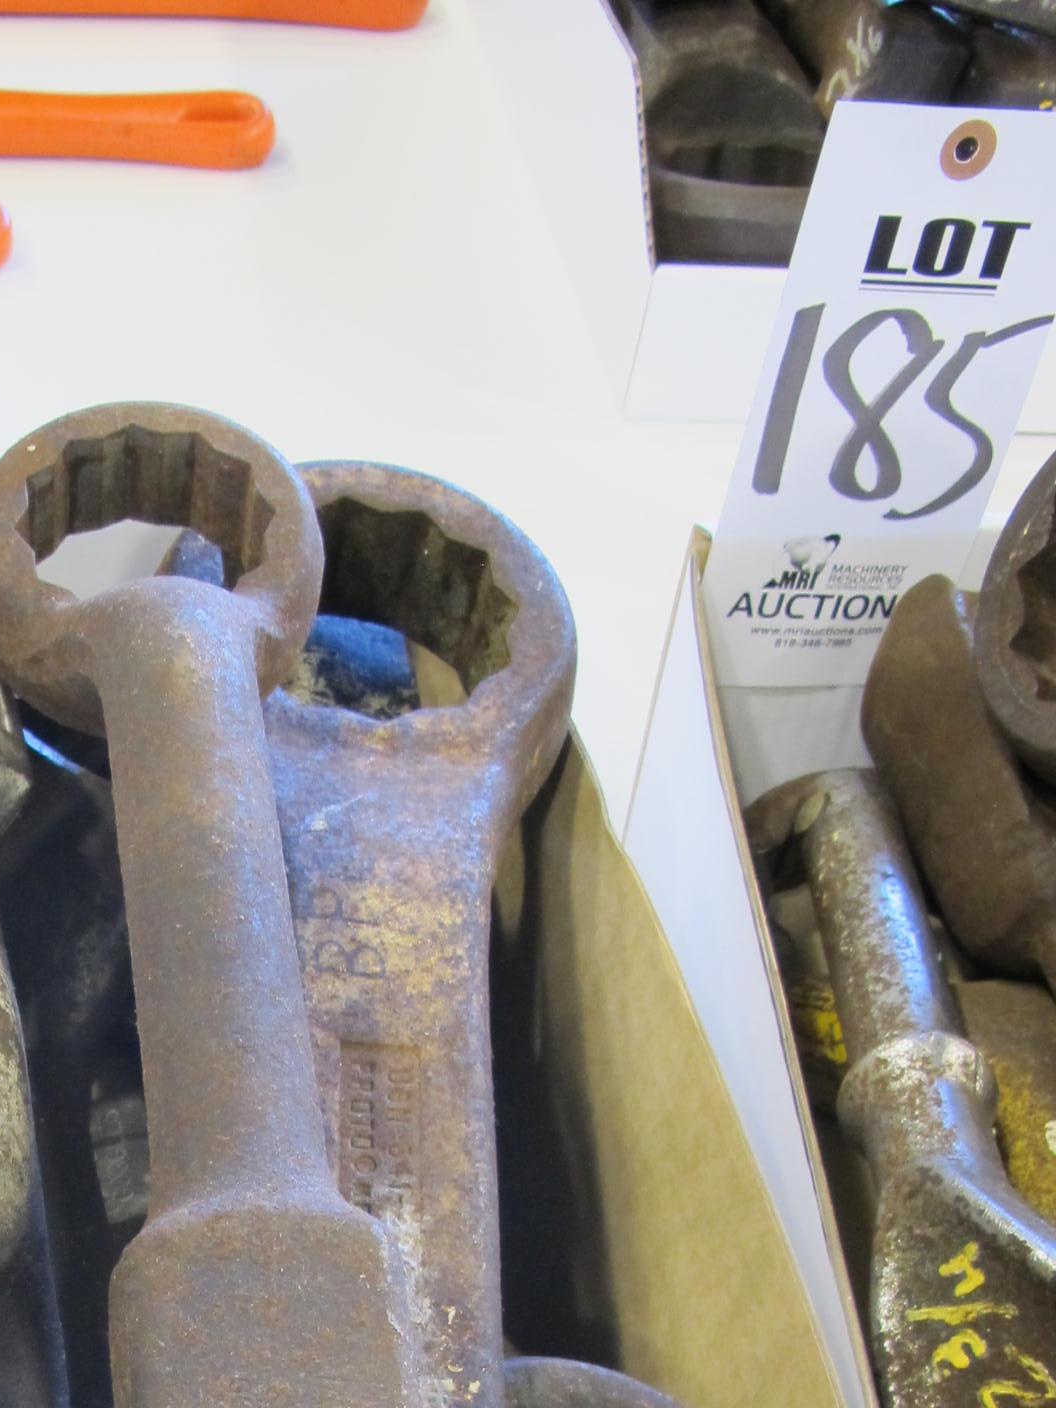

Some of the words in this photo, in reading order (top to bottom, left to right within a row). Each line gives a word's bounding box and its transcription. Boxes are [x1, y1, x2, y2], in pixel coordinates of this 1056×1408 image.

[863, 215, 1032, 280] LOT
[752, 303, 1056, 521] 185
[778, 570, 822, 590] MRI
[832, 564, 909, 575] MACHINERY
